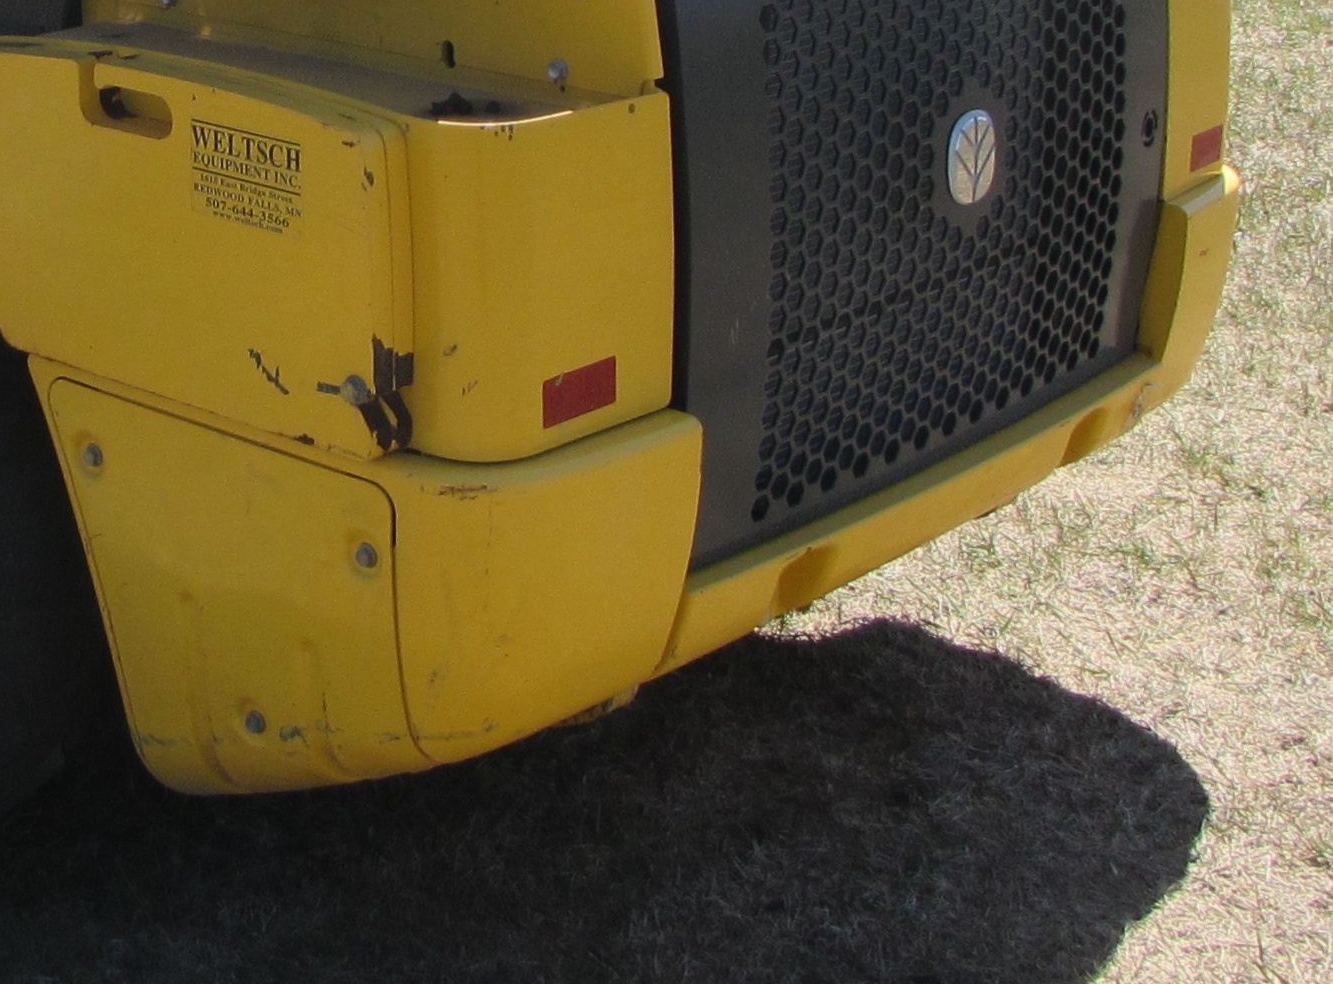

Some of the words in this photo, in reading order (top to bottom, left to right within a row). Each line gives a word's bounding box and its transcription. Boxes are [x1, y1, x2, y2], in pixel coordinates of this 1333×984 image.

[191, 124, 302, 173] WELTSCH
[193, 151, 271, 180] EQUIPMENT
[274, 170, 302, 190] INC.
[193, 182, 245, 203] REDWOOD
[248, 196, 283, 215] FALLS,
[285, 206, 302, 217] MN
[220, 176, 237, 189] East
[239, 181, 267, 197] Bridge
[268, 189, 293, 204] Street
[205, 196, 290, 228] 507-644-3566
